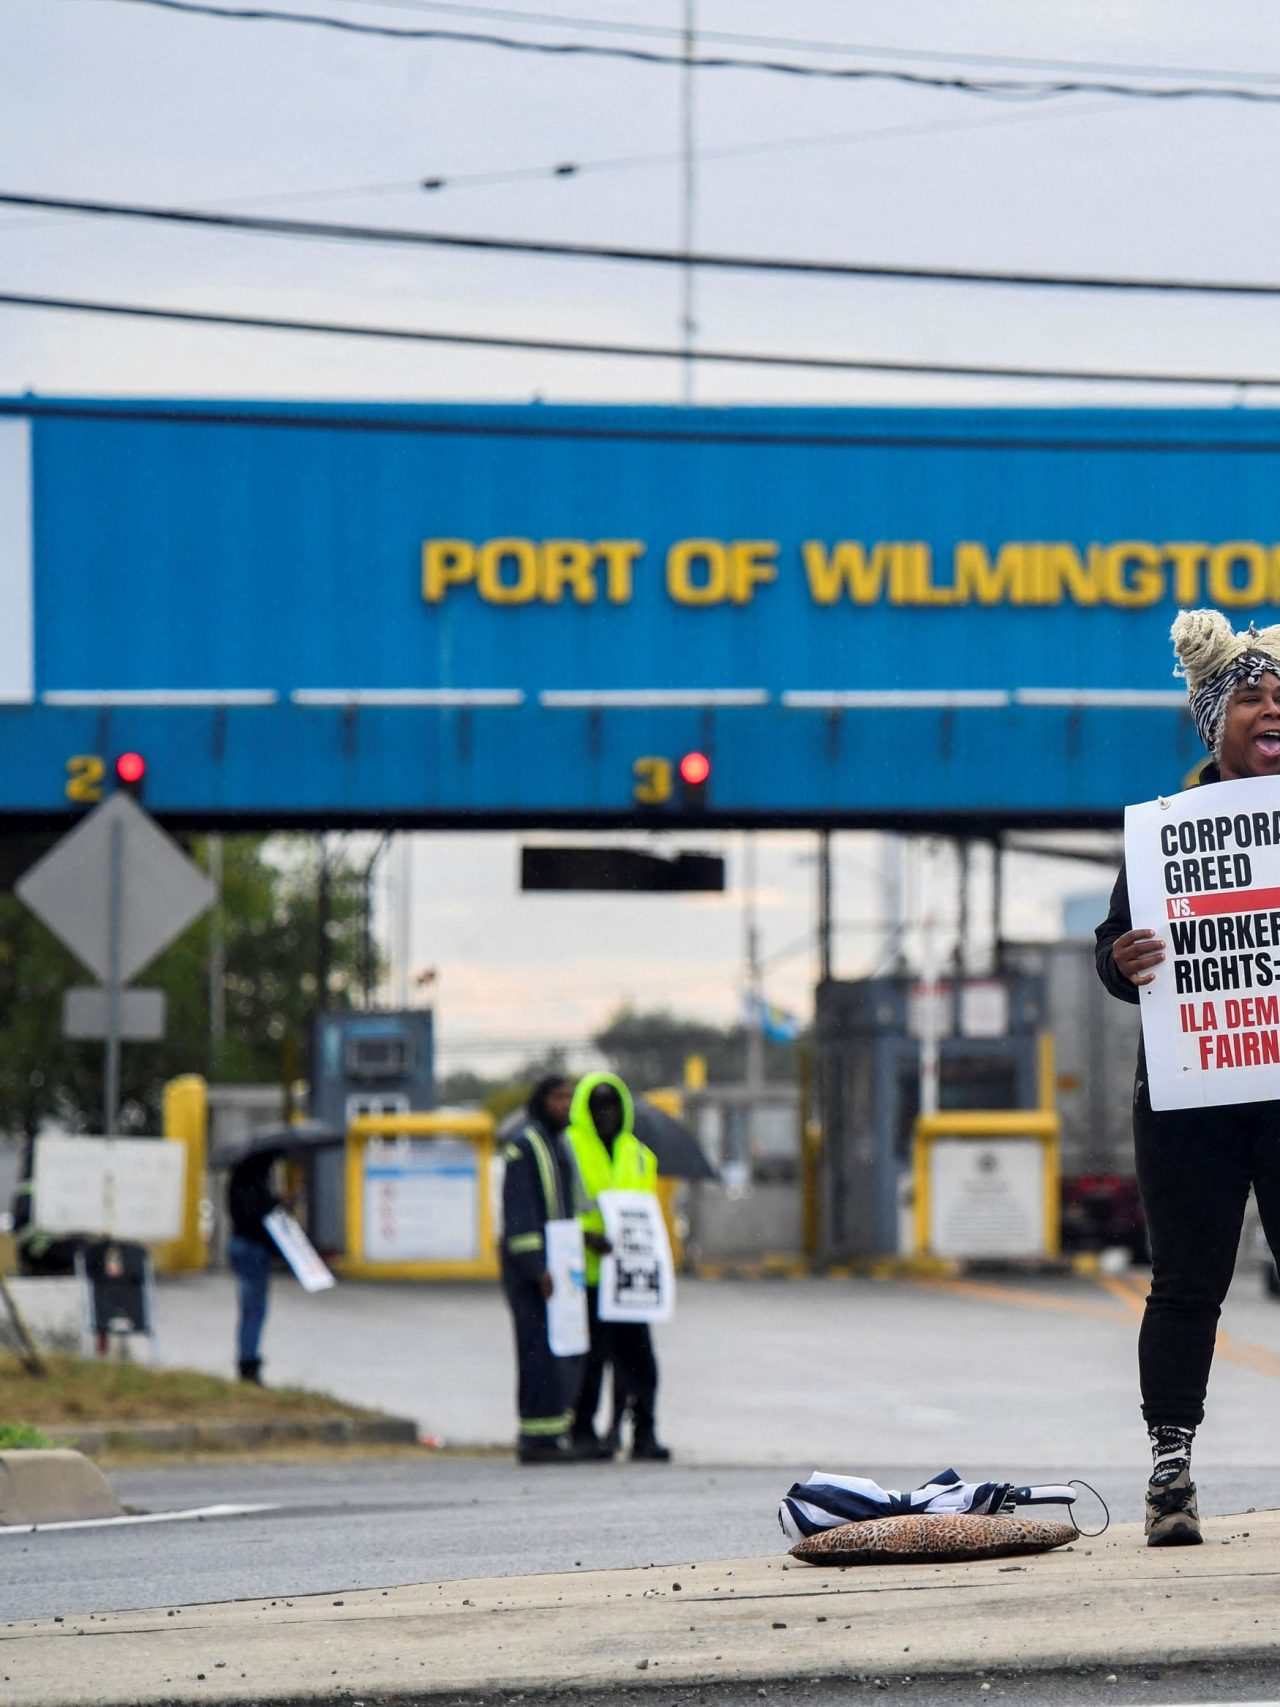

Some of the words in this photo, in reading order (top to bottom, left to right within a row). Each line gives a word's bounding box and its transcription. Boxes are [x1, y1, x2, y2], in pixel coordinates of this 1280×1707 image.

[421, 538, 644, 604] PORT
[667, 538, 779, 606] OF
[66, 755, 103, 802] 2
[634, 756, 671, 804] 3
[1163, 853, 1252, 894] GREED
[1171, 898, 1195, 917] VS.
[1180, 1001, 1218, 1033] ILA
